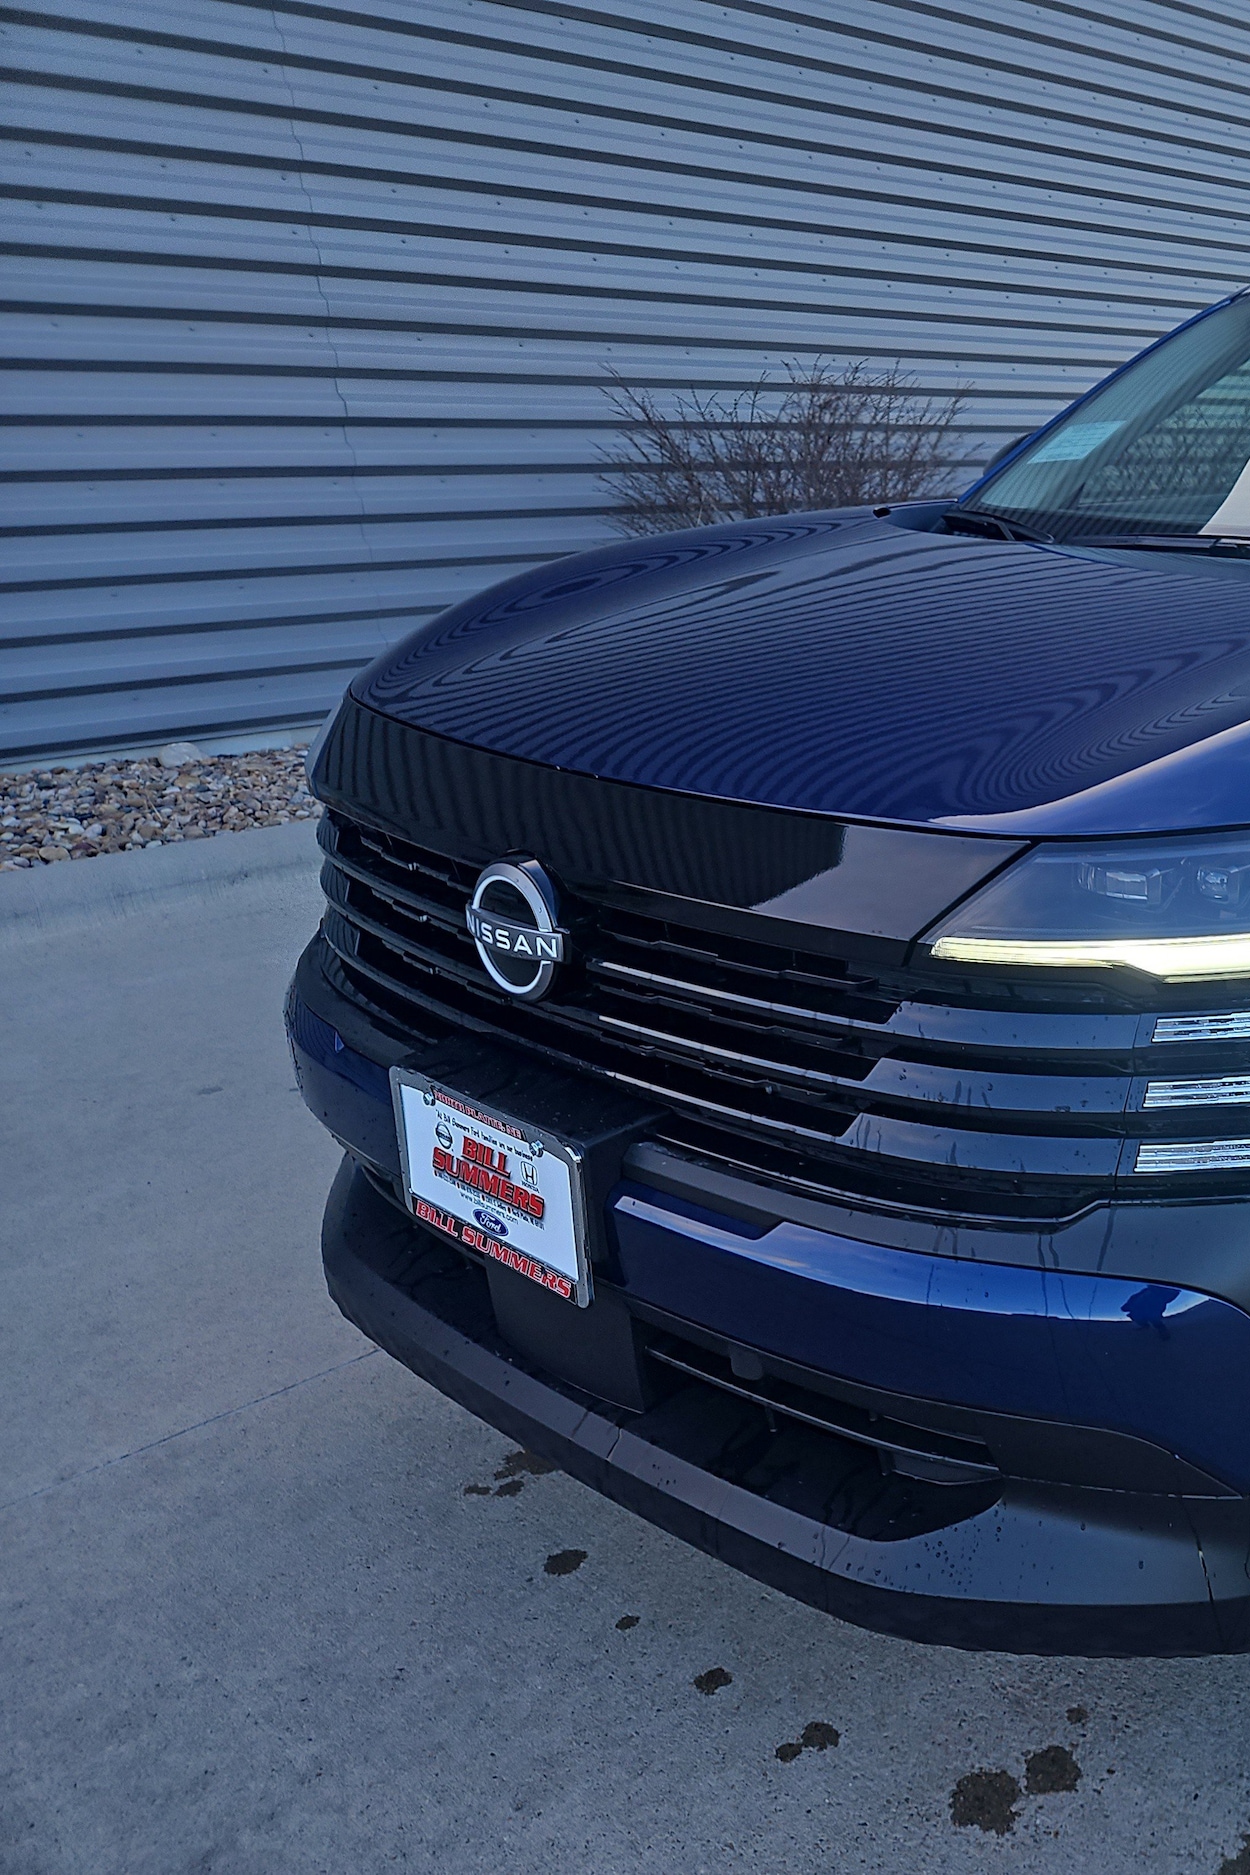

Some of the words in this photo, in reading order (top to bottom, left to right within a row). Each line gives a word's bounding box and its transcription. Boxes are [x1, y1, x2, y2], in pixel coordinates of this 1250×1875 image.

[466, 908, 558, 958] NISSAN
[461, 1136, 512, 1178] BILL
[432, 1147, 544, 1218] SUMMERS
[479, 1212, 502, 1233] Ford
[415, 1199, 458, 1237] BILL
[461, 1225, 572, 1298] SUMMERS
